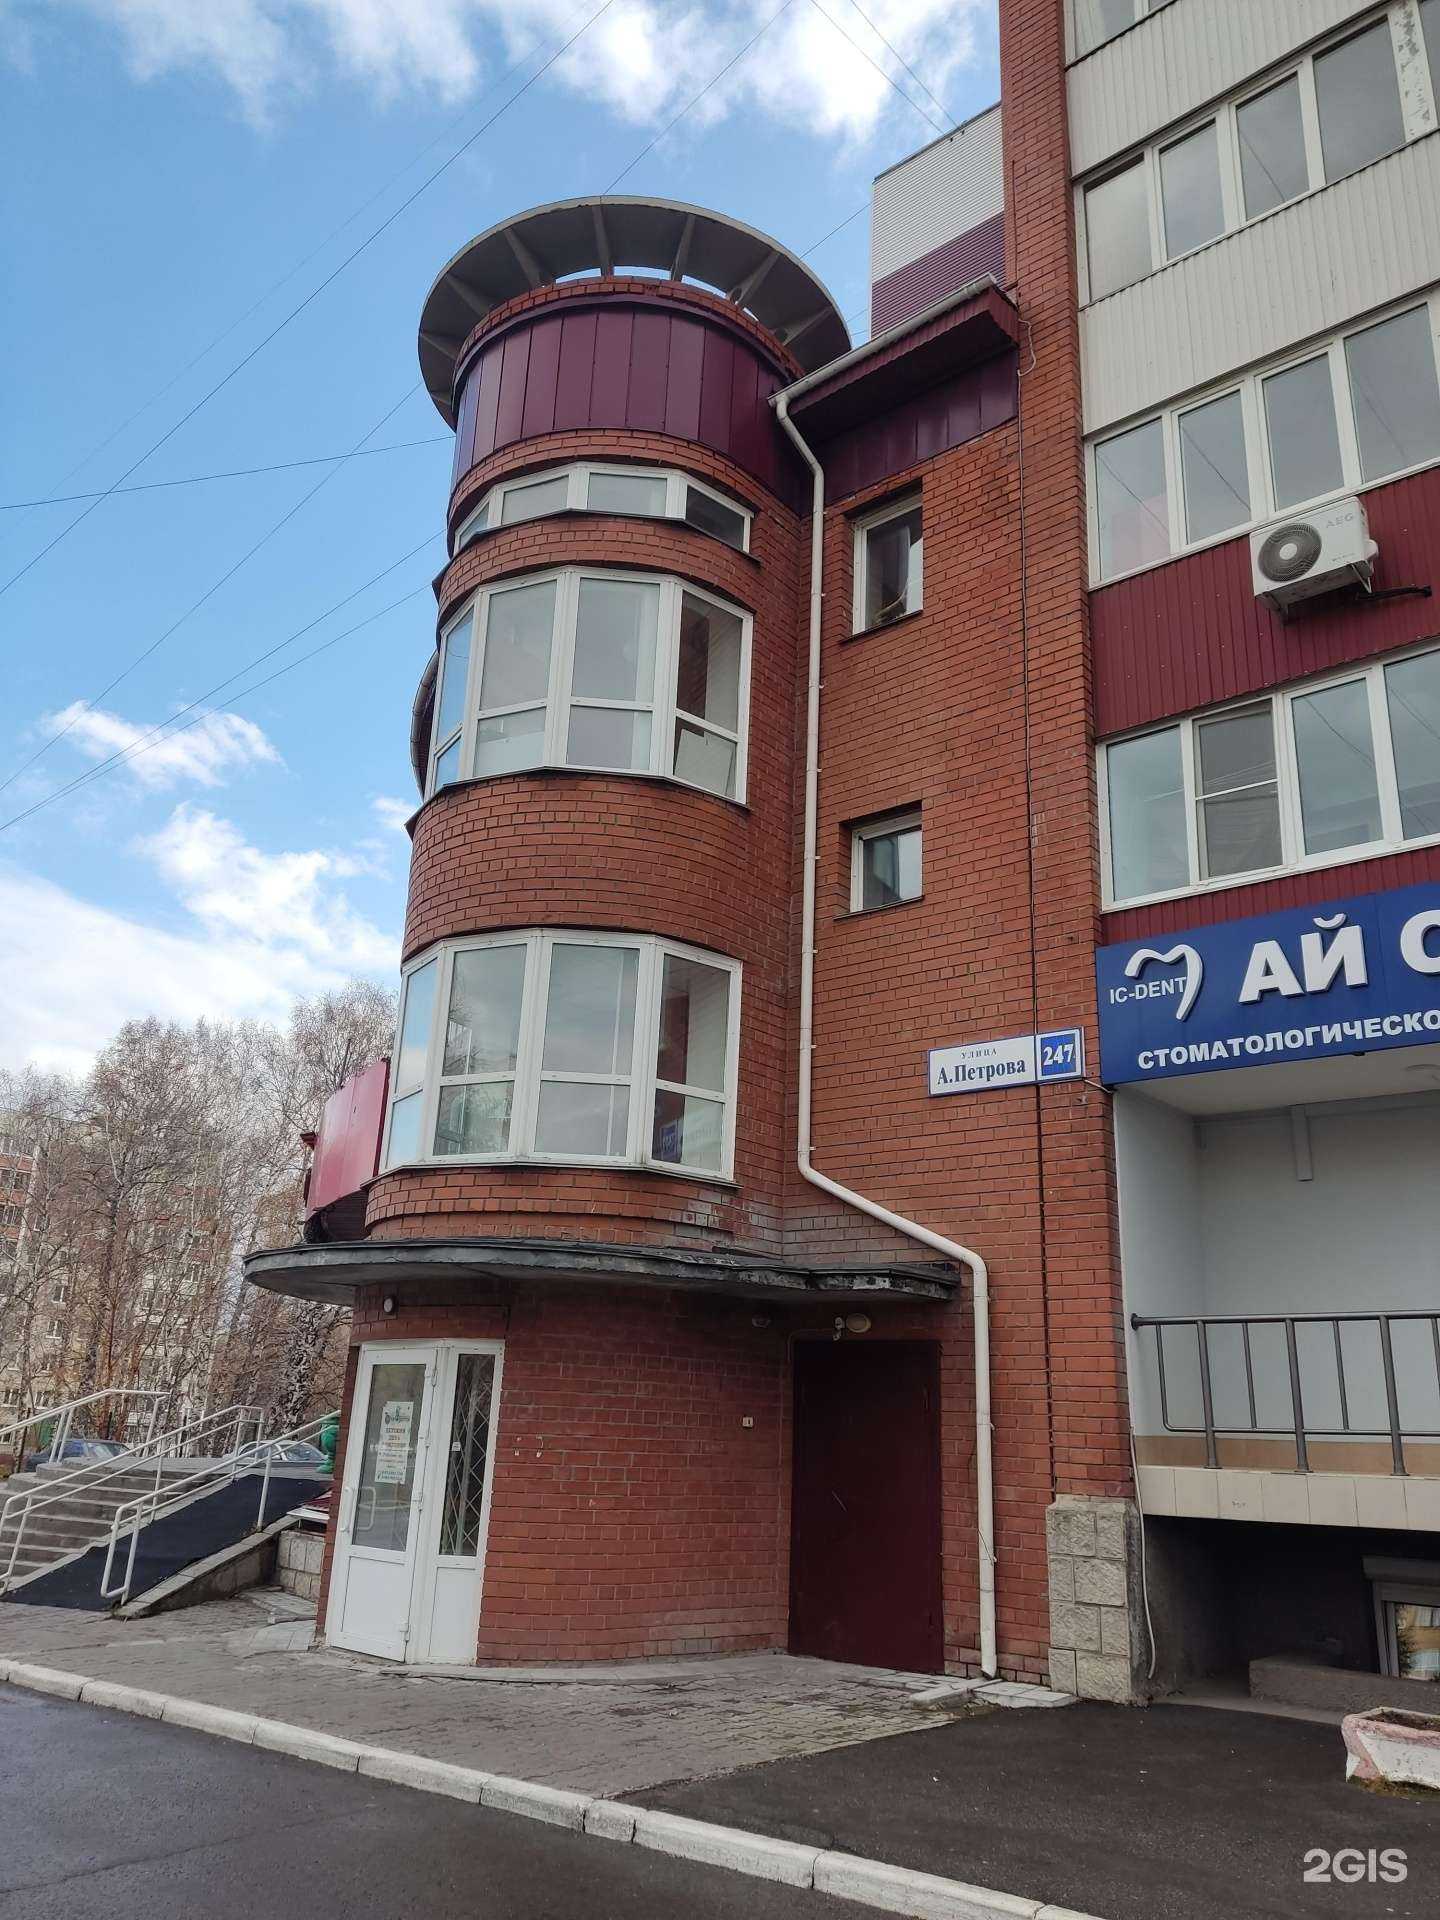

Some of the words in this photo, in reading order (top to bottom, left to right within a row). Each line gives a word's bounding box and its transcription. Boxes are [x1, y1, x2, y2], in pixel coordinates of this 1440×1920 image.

[1239, 912, 1368, 1004] АЙ
[1110, 976, 1187, 1004] IC-DENT
[1137, 1009, 1440, 1071] СТОМАТОЛОГИЧЕСКО
[1043, 1043, 1074, 1067] 247
[937, 1059, 1026, 1085] А.Петрова
